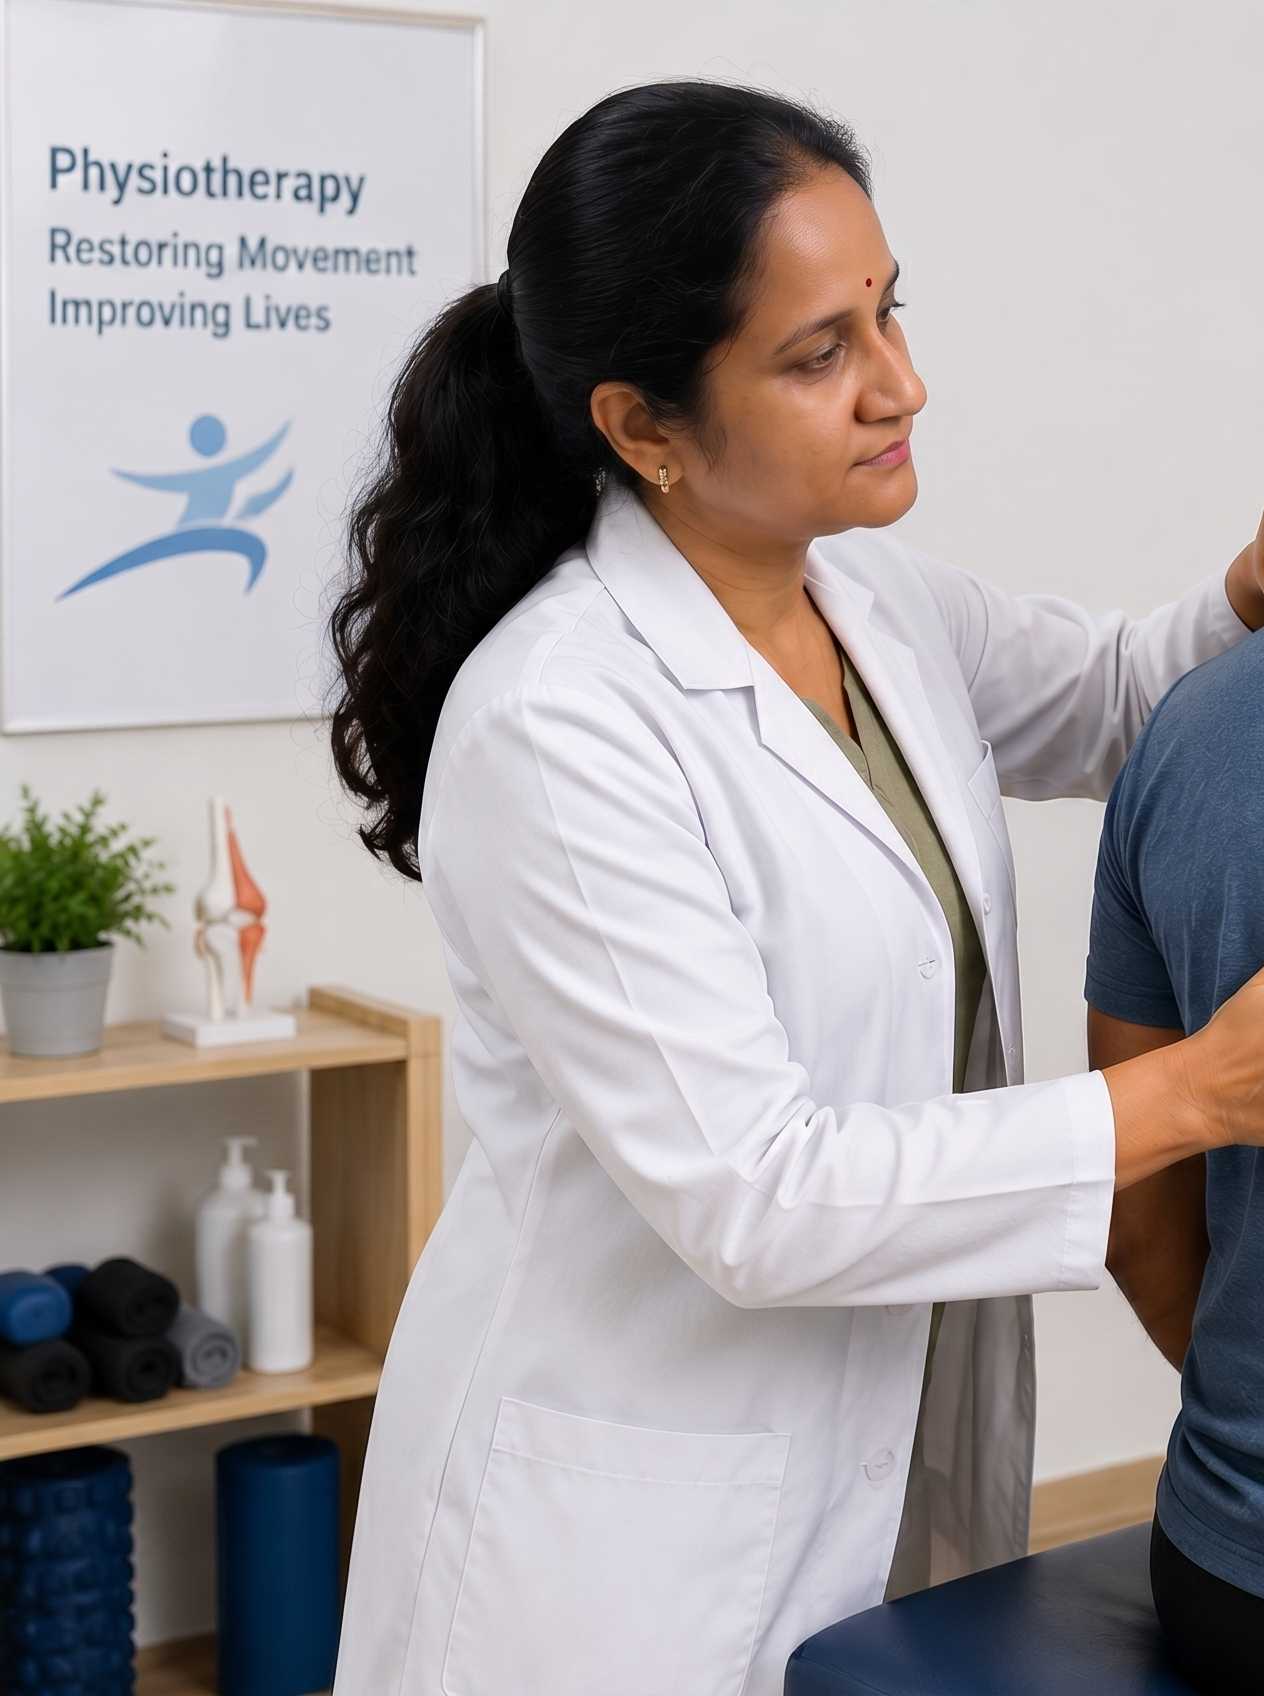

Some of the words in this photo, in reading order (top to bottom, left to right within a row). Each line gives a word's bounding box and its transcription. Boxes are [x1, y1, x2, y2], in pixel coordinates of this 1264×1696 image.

[49, 145, 366, 216] Physiotherapy
[49, 227, 226, 280] Restoring
[237, 234, 418, 277] Movement
[49, 288, 231, 338] Improving
[243, 293, 332, 333] Lives
